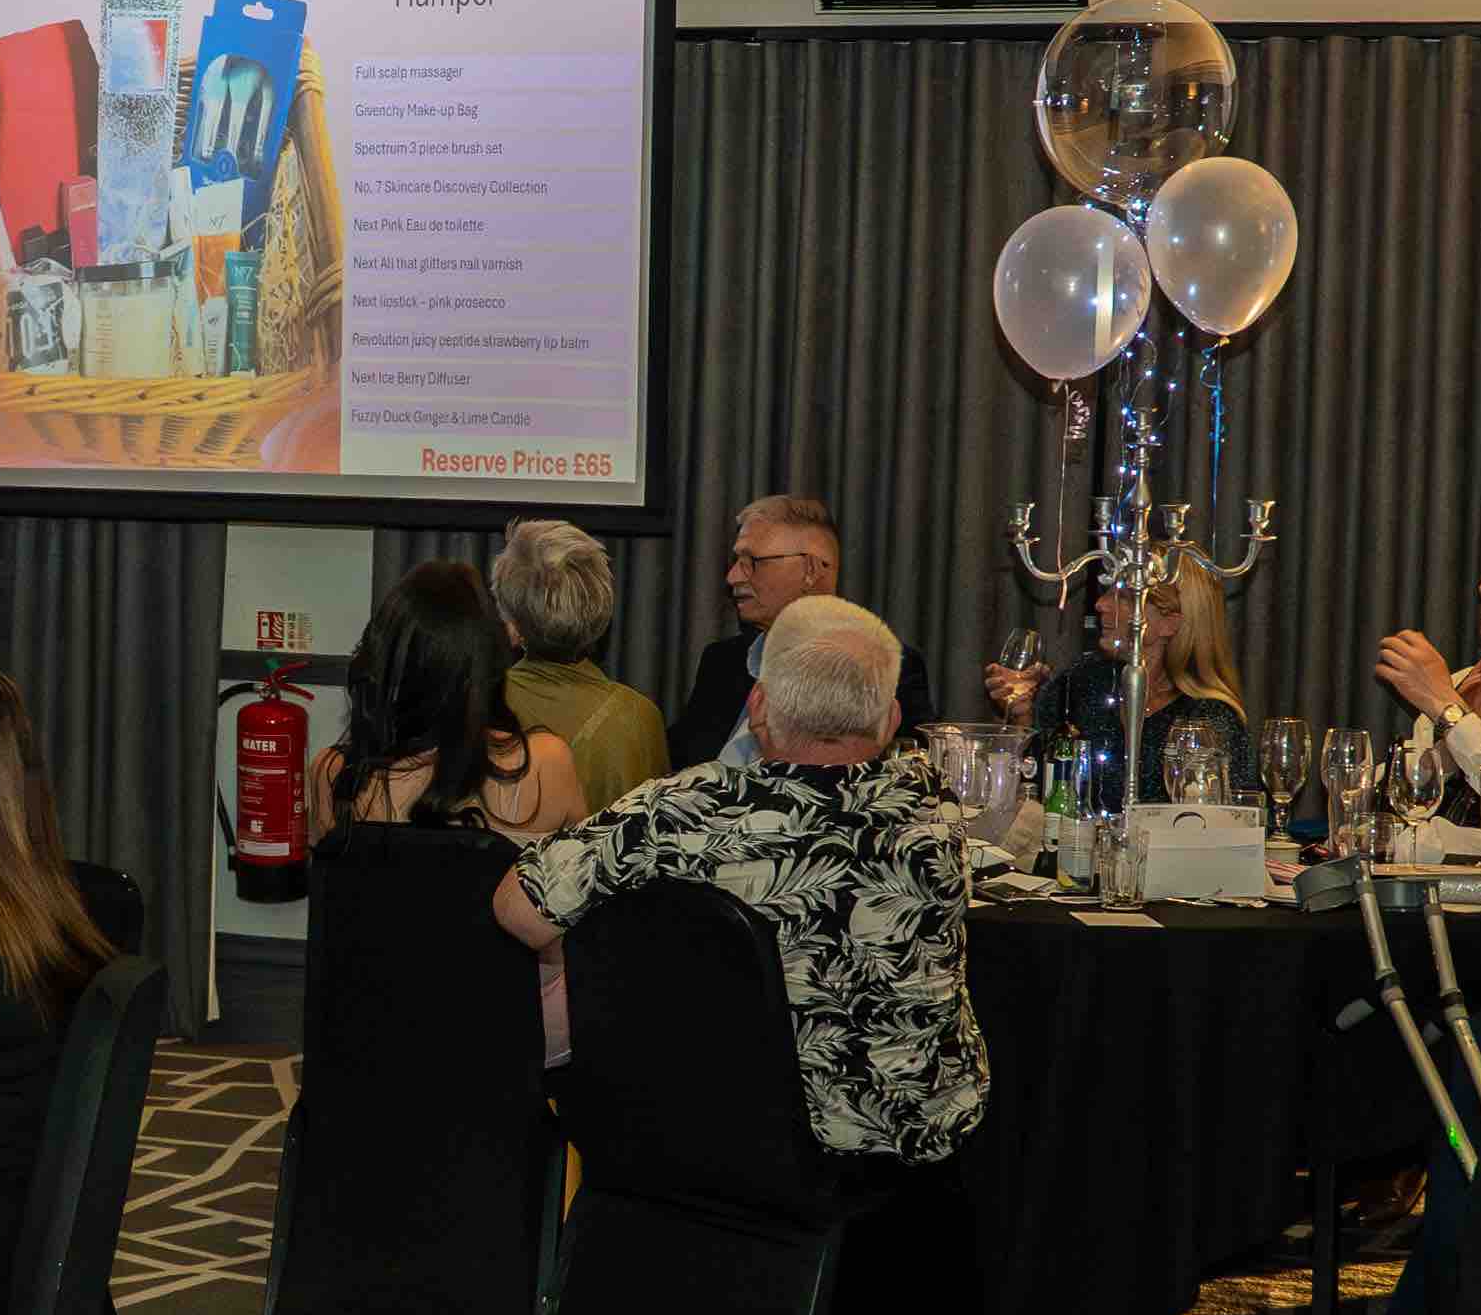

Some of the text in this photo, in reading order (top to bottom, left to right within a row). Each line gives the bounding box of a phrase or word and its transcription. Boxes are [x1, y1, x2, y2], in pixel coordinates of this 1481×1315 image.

[355, 65, 464, 81] Full scalp massager
[355, 103, 479, 120] Givenchy Make-up Bag
[354, 141, 504, 156] Spectrum 3 piece brush set
[376, 180, 383, 193] 7
[384, 180, 431, 194] Skincare
[433, 180, 488, 196] Discovery
[490, 180, 549, 194] Collection
[353, 219, 485, 233] Next Pink Eau de toilette
[353, 256, 523, 273] Next All that glitters nail varnish
[352, 294, 377, 309] Next
[382, 294, 417, 310] lipstick
[428, 295, 452, 311] pink
[454, 298, 506, 312] prosecco
[352, 333, 590, 352] Revolution juicy peptide strawberry lip balm
[351, 371, 472, 388] Next Ice Berry Diffuser
[351, 409, 531, 428] Fuzzy Duck Ginger & Lime Candle
[421, 448, 613, 477] Reserve Price £65
